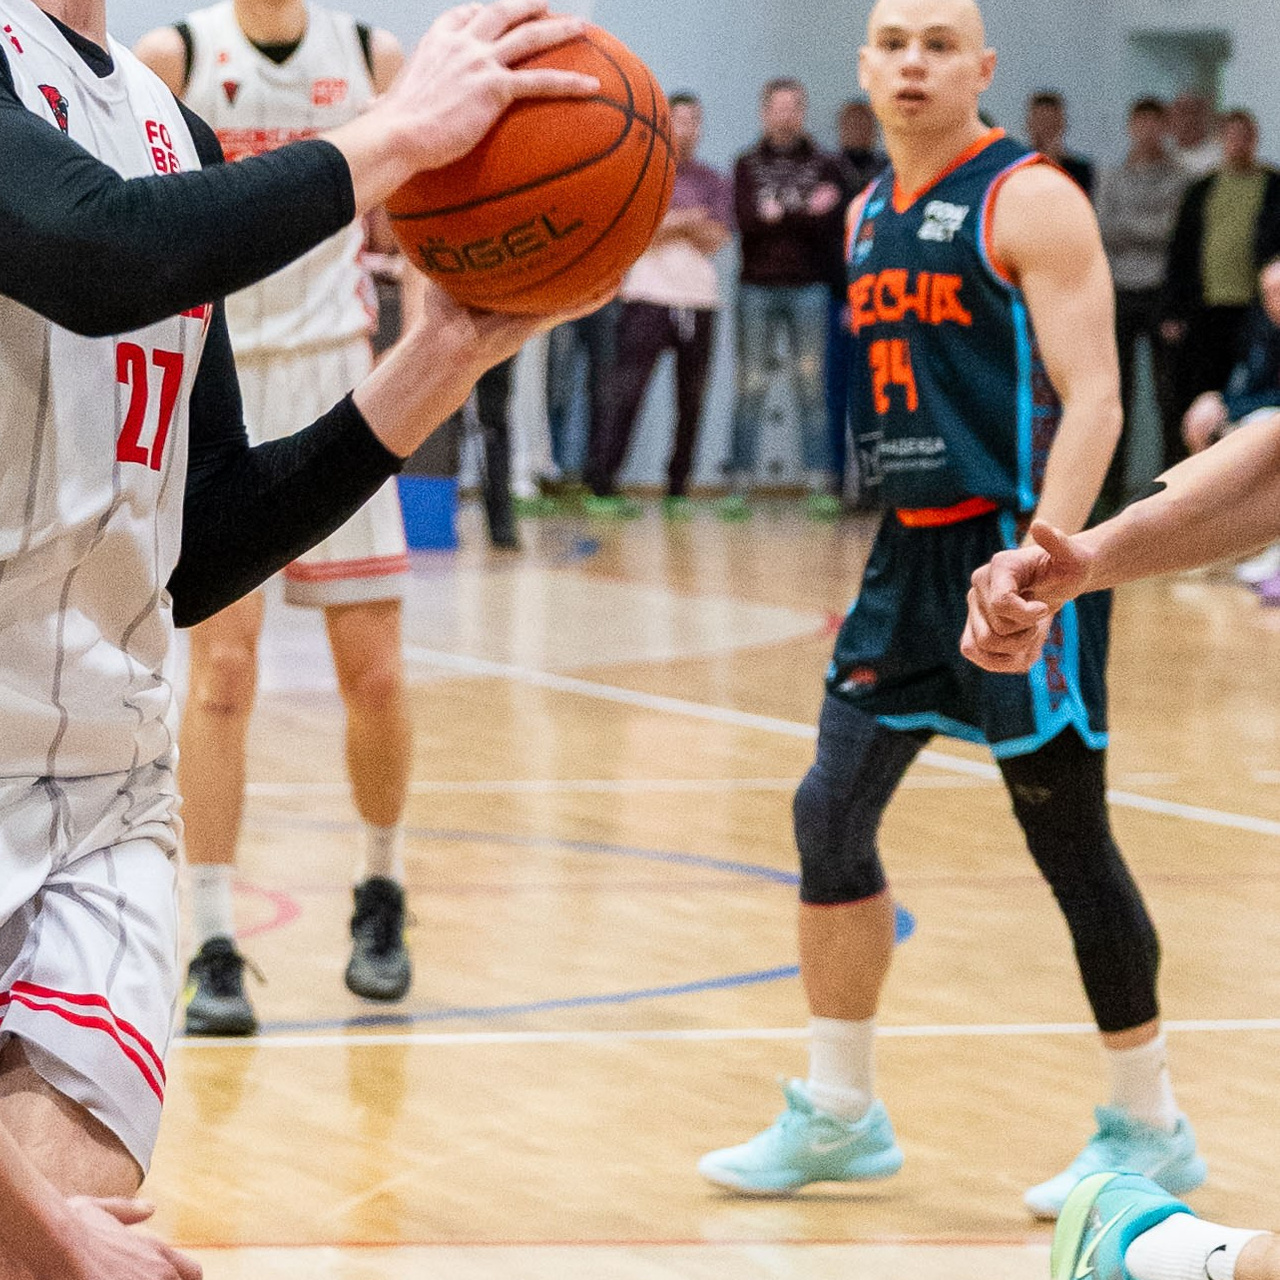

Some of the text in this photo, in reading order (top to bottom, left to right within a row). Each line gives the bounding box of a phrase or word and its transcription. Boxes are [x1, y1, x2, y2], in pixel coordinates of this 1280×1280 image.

[145, 120, 173, 151] FO
[151, 146, 181, 174] BE
[848, 268, 972, 336] ЕСНА
[116, 342, 184, 472] 27
[869, 339, 919, 414] 14
